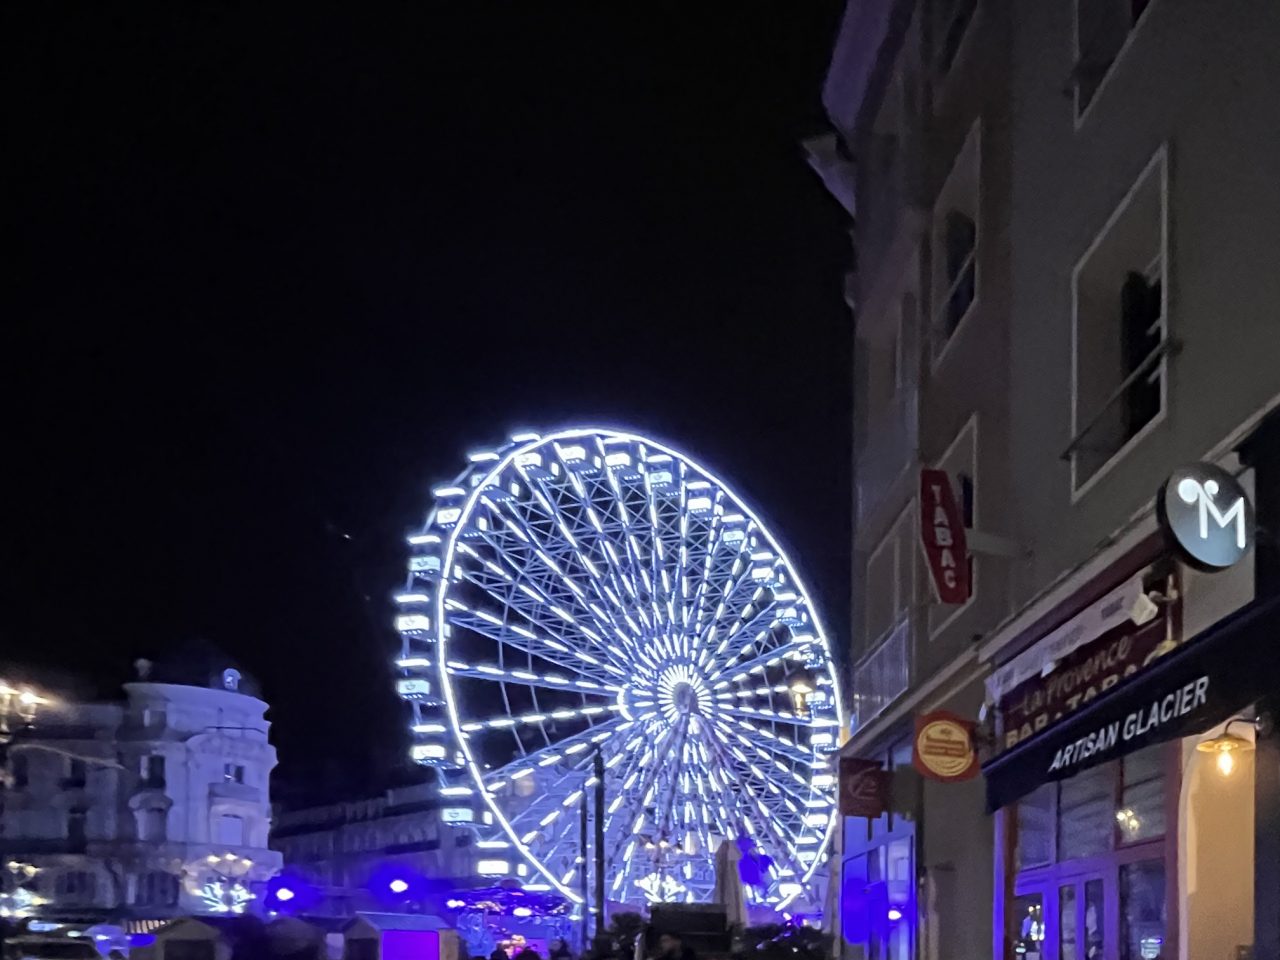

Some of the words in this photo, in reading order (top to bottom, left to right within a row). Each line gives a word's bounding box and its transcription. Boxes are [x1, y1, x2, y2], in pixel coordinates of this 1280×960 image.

[930, 483, 957, 589] TABAC
[1005, 712, 1049, 749] BAR
[1047, 719, 1120, 774] ARTISAN
[1122, 675, 1211, 741] GLACIER
